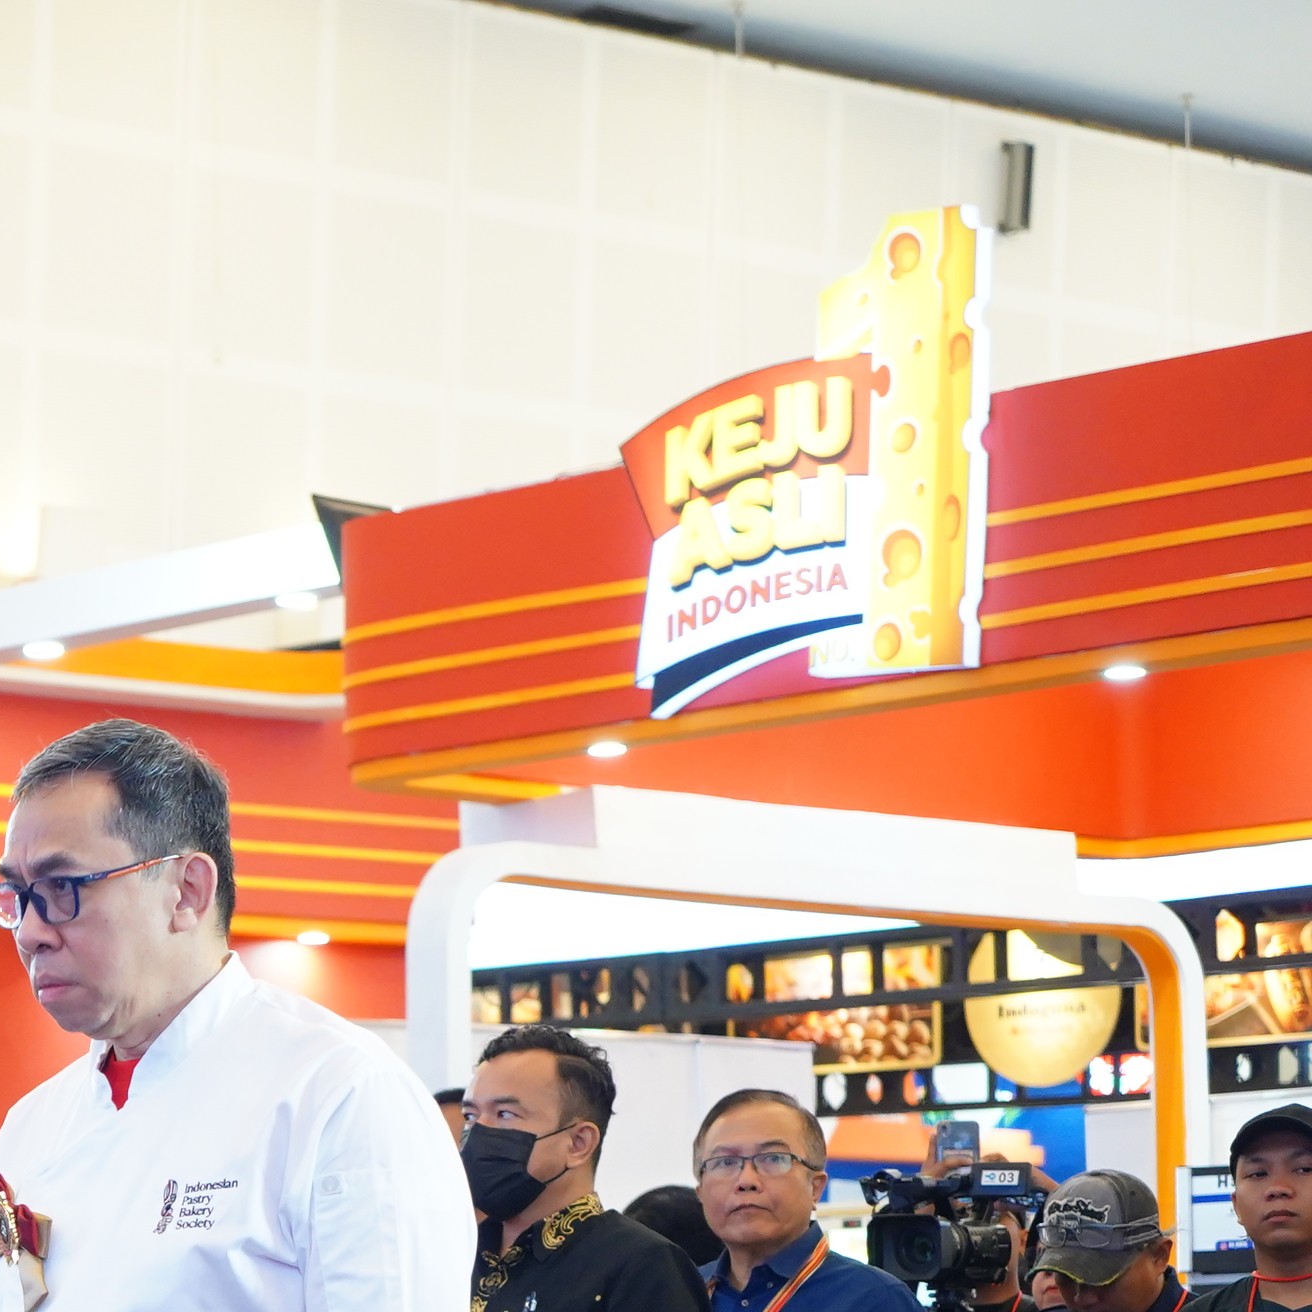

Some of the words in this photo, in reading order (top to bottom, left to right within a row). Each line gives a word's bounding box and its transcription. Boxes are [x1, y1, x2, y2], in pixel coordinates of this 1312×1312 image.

[665, 376, 853, 508] KEJU
[670, 463, 846, 590] ASLI
[667, 563, 848, 642] INDONESIA
[998, 1172, 1015, 1184] 03
[185, 1179, 238, 1194] Indonesian
[182, 1194, 213, 1206] Pastry
[179, 1206, 214, 1218] Bakery
[176, 1218, 215, 1231] Society
